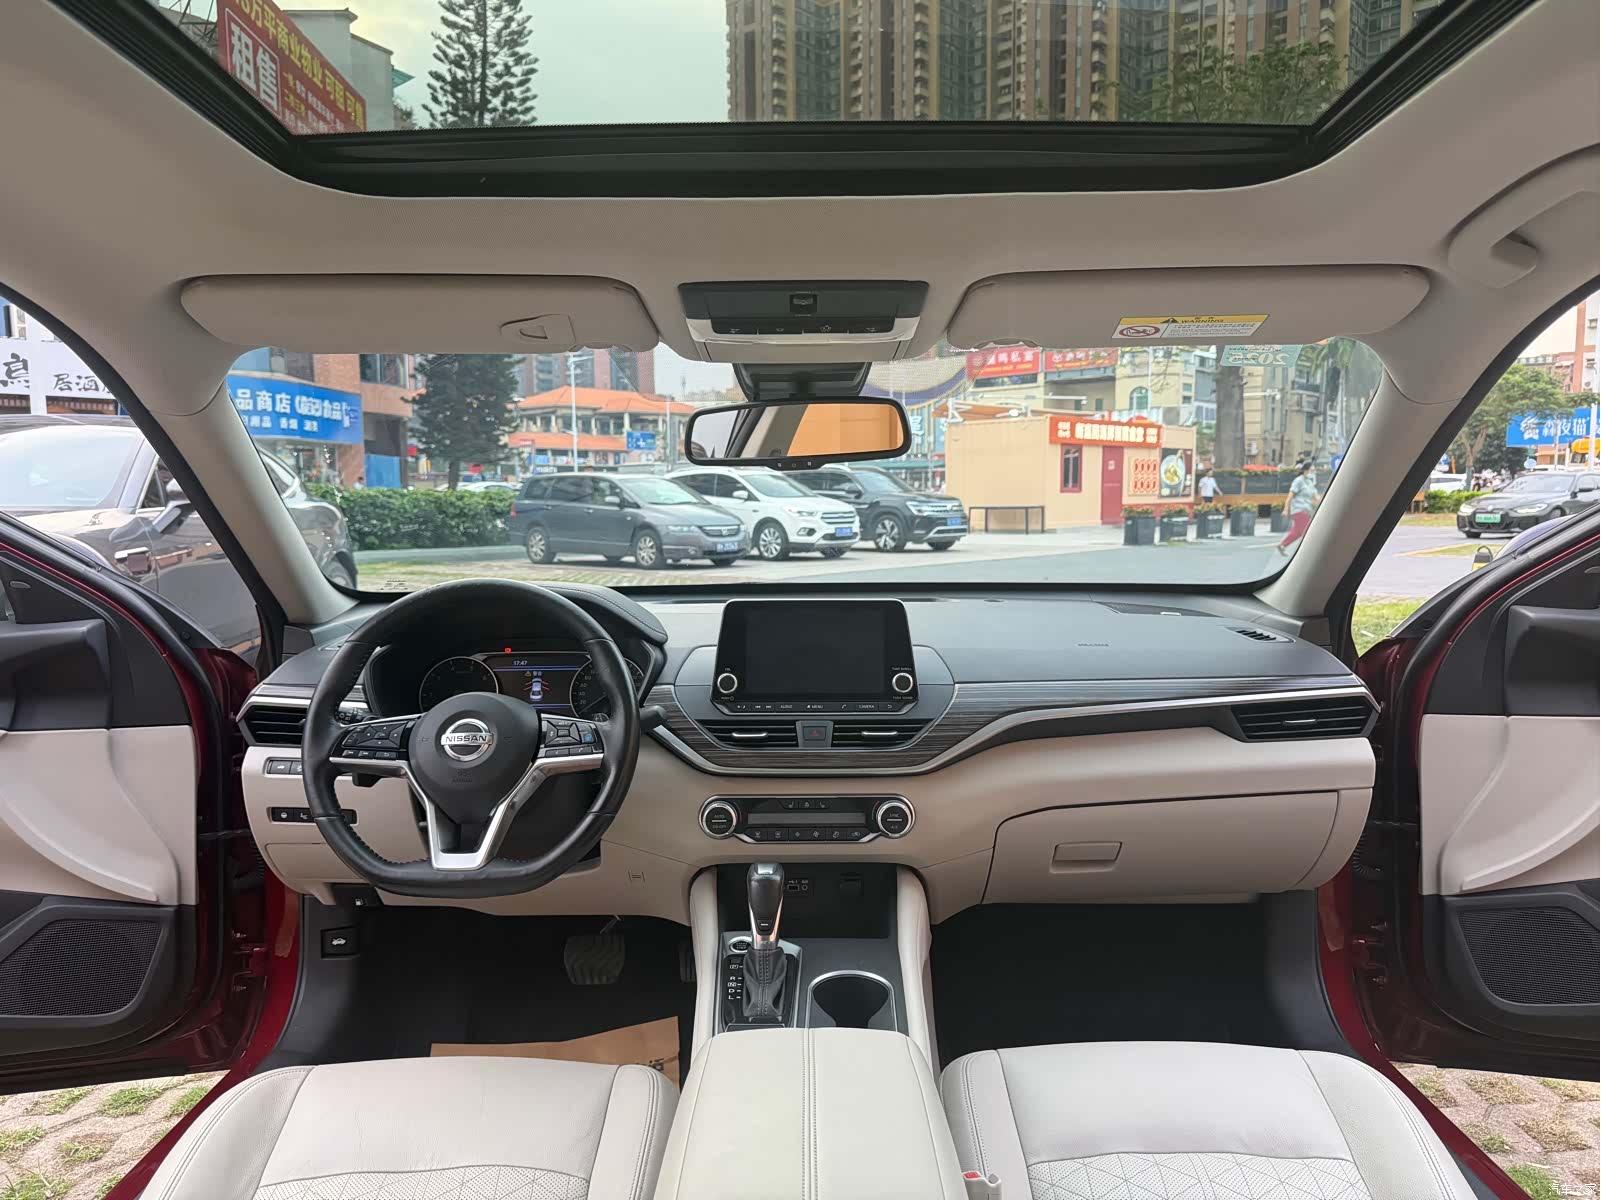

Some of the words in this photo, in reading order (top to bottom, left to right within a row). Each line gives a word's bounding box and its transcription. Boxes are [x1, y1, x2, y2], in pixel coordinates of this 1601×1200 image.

[230, 22, 278, 110] 租售
[52, 373, 112, 394] 居酒
[445, 734, 488, 743] NISSAN
